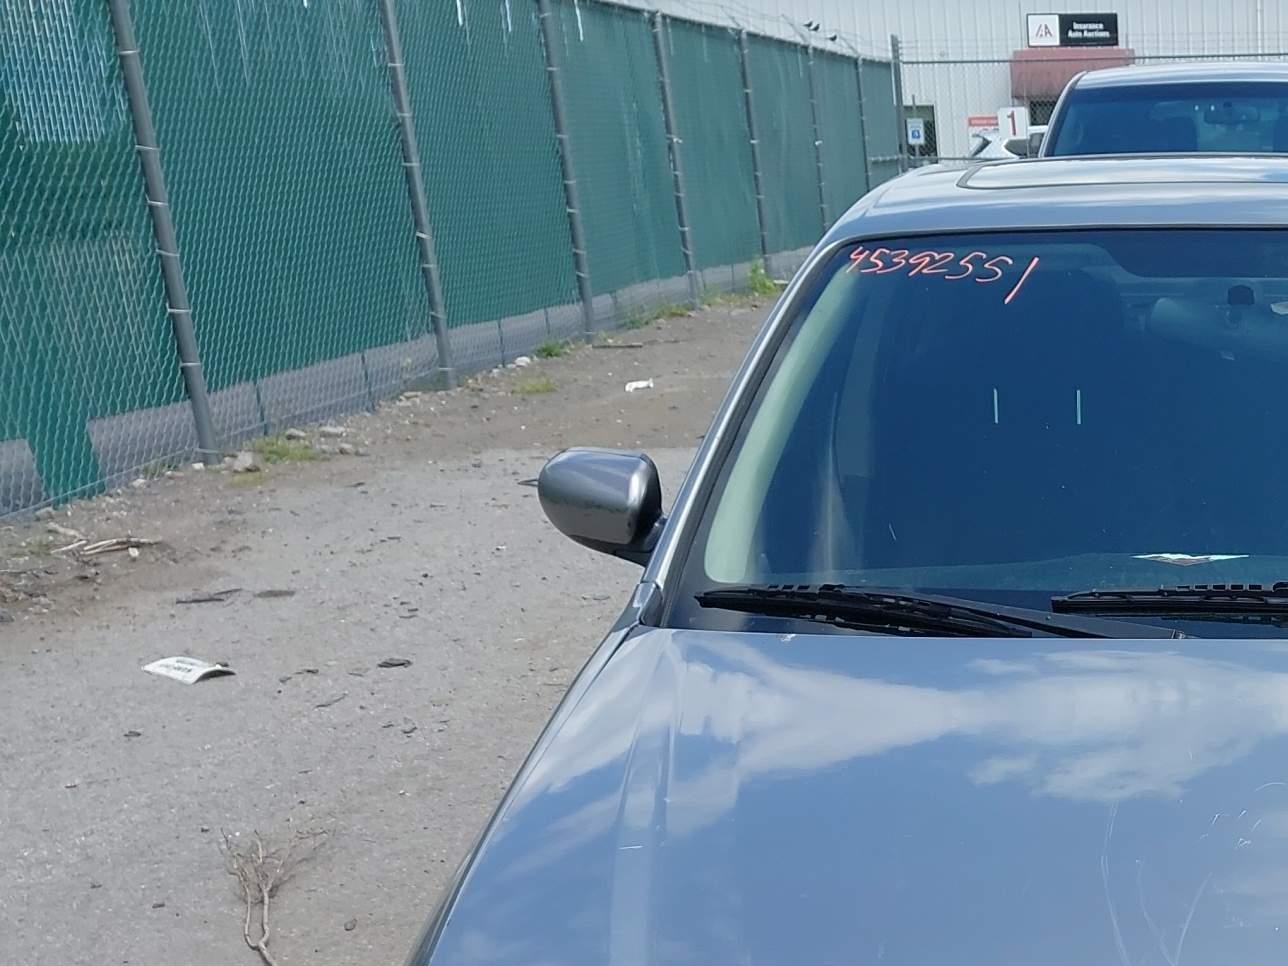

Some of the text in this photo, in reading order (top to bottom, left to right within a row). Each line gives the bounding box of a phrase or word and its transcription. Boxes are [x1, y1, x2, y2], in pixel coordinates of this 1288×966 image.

[1072, 21, 1105, 31] Insurance
[1006, 110, 1017, 136] 1
[845, 246, 1040, 305] 45392551
